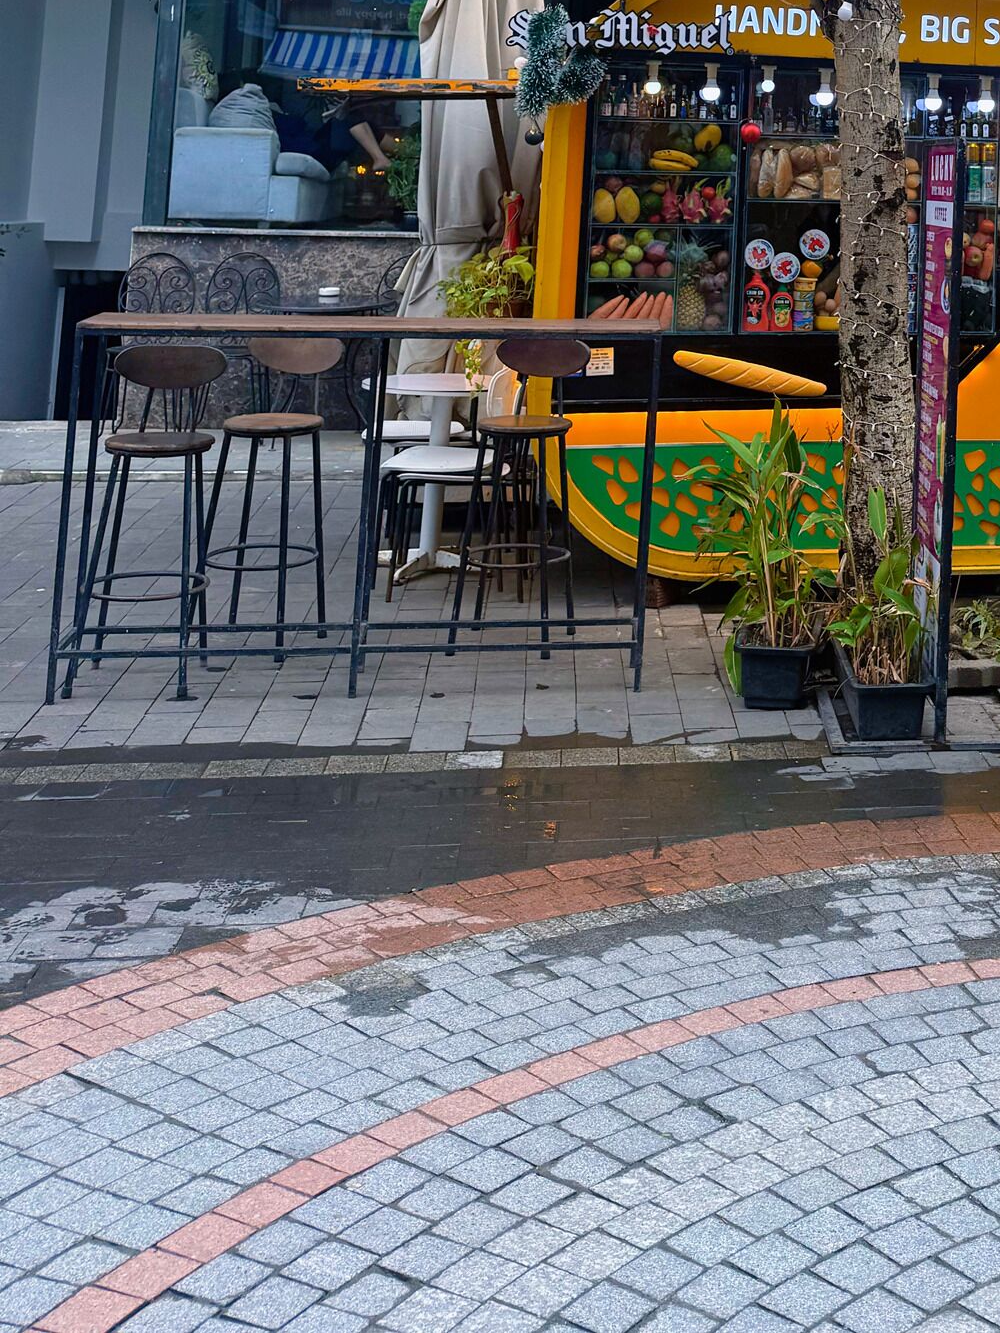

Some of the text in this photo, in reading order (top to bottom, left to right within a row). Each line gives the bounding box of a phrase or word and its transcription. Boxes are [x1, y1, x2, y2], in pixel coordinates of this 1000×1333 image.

[506, 7, 734, 55] Sn Miguel
[715, 4, 906, 44] HAND,
[920, 14, 970, 44] BIG
